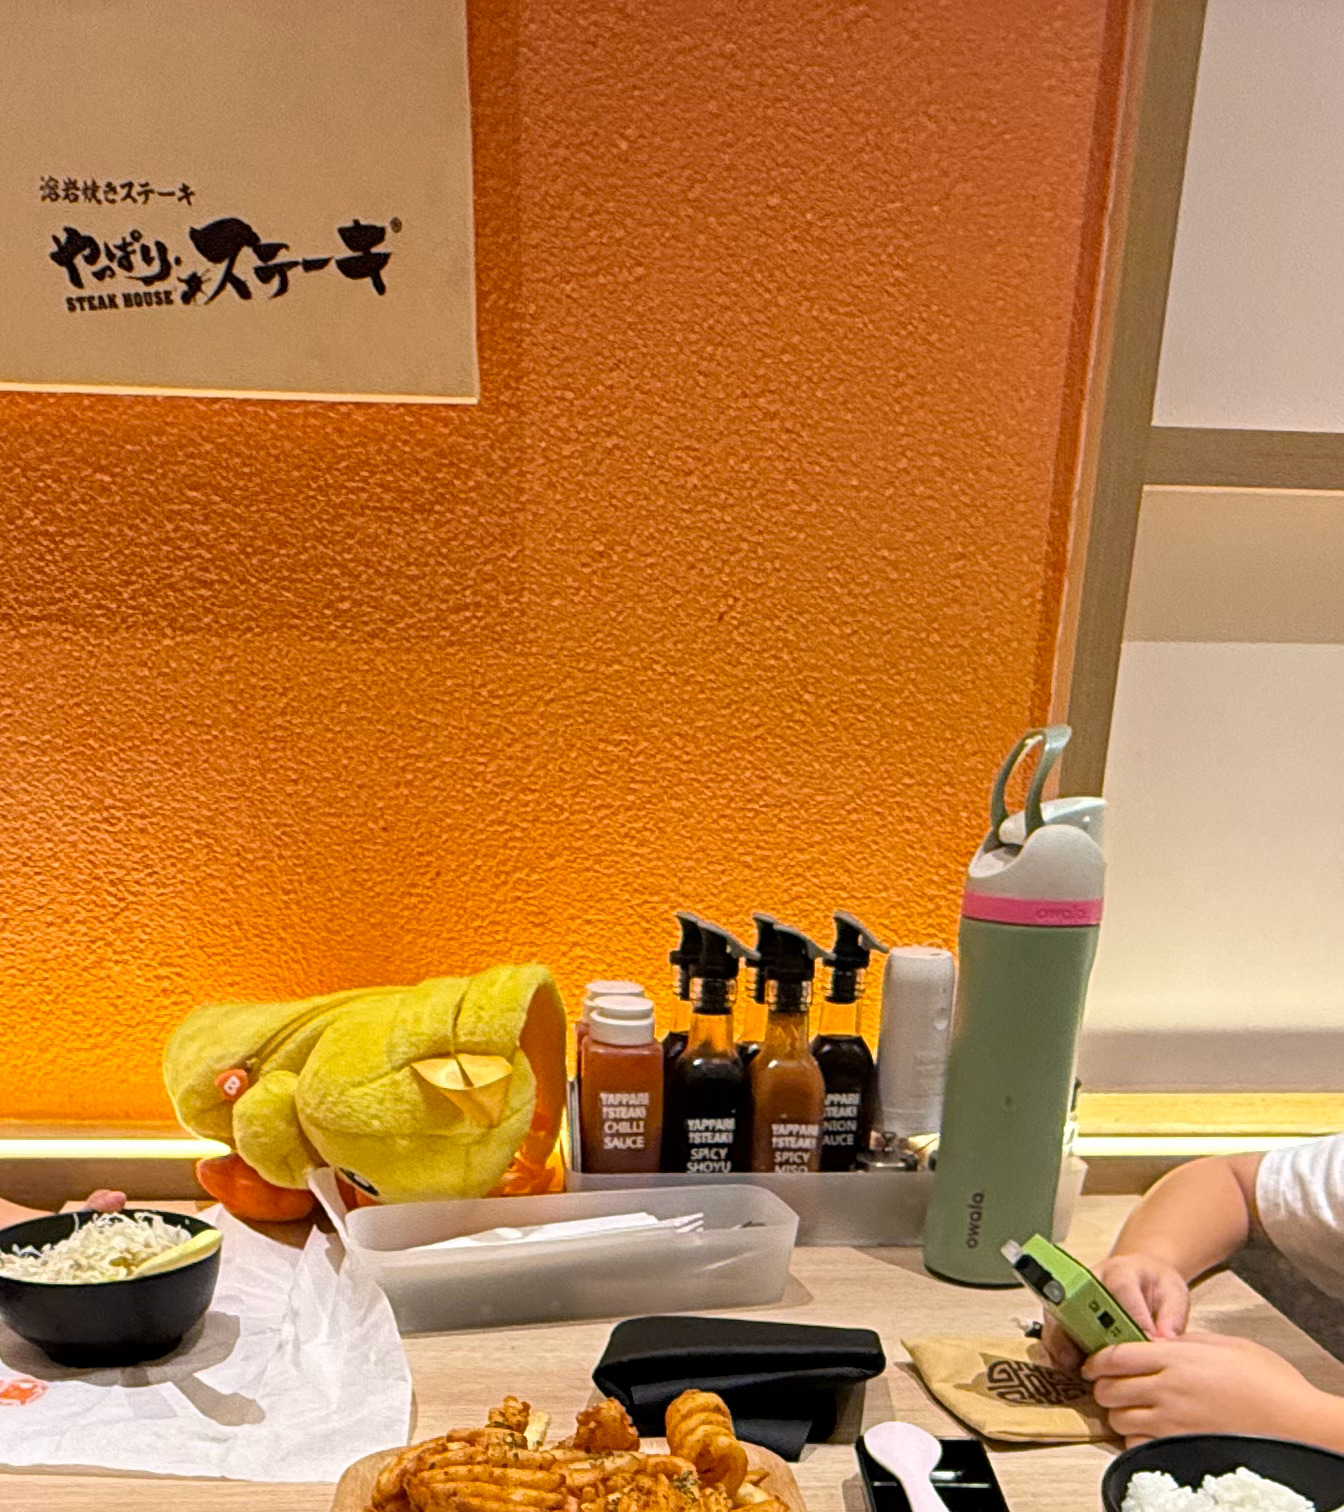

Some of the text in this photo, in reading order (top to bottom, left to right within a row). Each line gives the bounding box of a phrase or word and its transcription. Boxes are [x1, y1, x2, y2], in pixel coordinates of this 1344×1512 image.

[39, 175, 195, 206] 溶岩焼きステーキ
[66, 290, 174, 312] STEAK HOUSE
[599, 1092, 649, 1105] YAPPARI
[604, 1121, 645, 1134] CHILLI
[687, 1118, 736, 1131] YAPPARI
[771, 1124, 819, 1136] YAPPARI
[823, 1120, 857, 1131] NION
[604, 1136, 645, 1150] SAUCE
[822, 1134, 855, 1146] AUCE
[690, 1147, 728, 1160] SPICY
[774, 1151, 810, 1163] SPICY
[686, 1160, 732, 1173] SHOYU
[967, 1192, 984, 1249] owala
